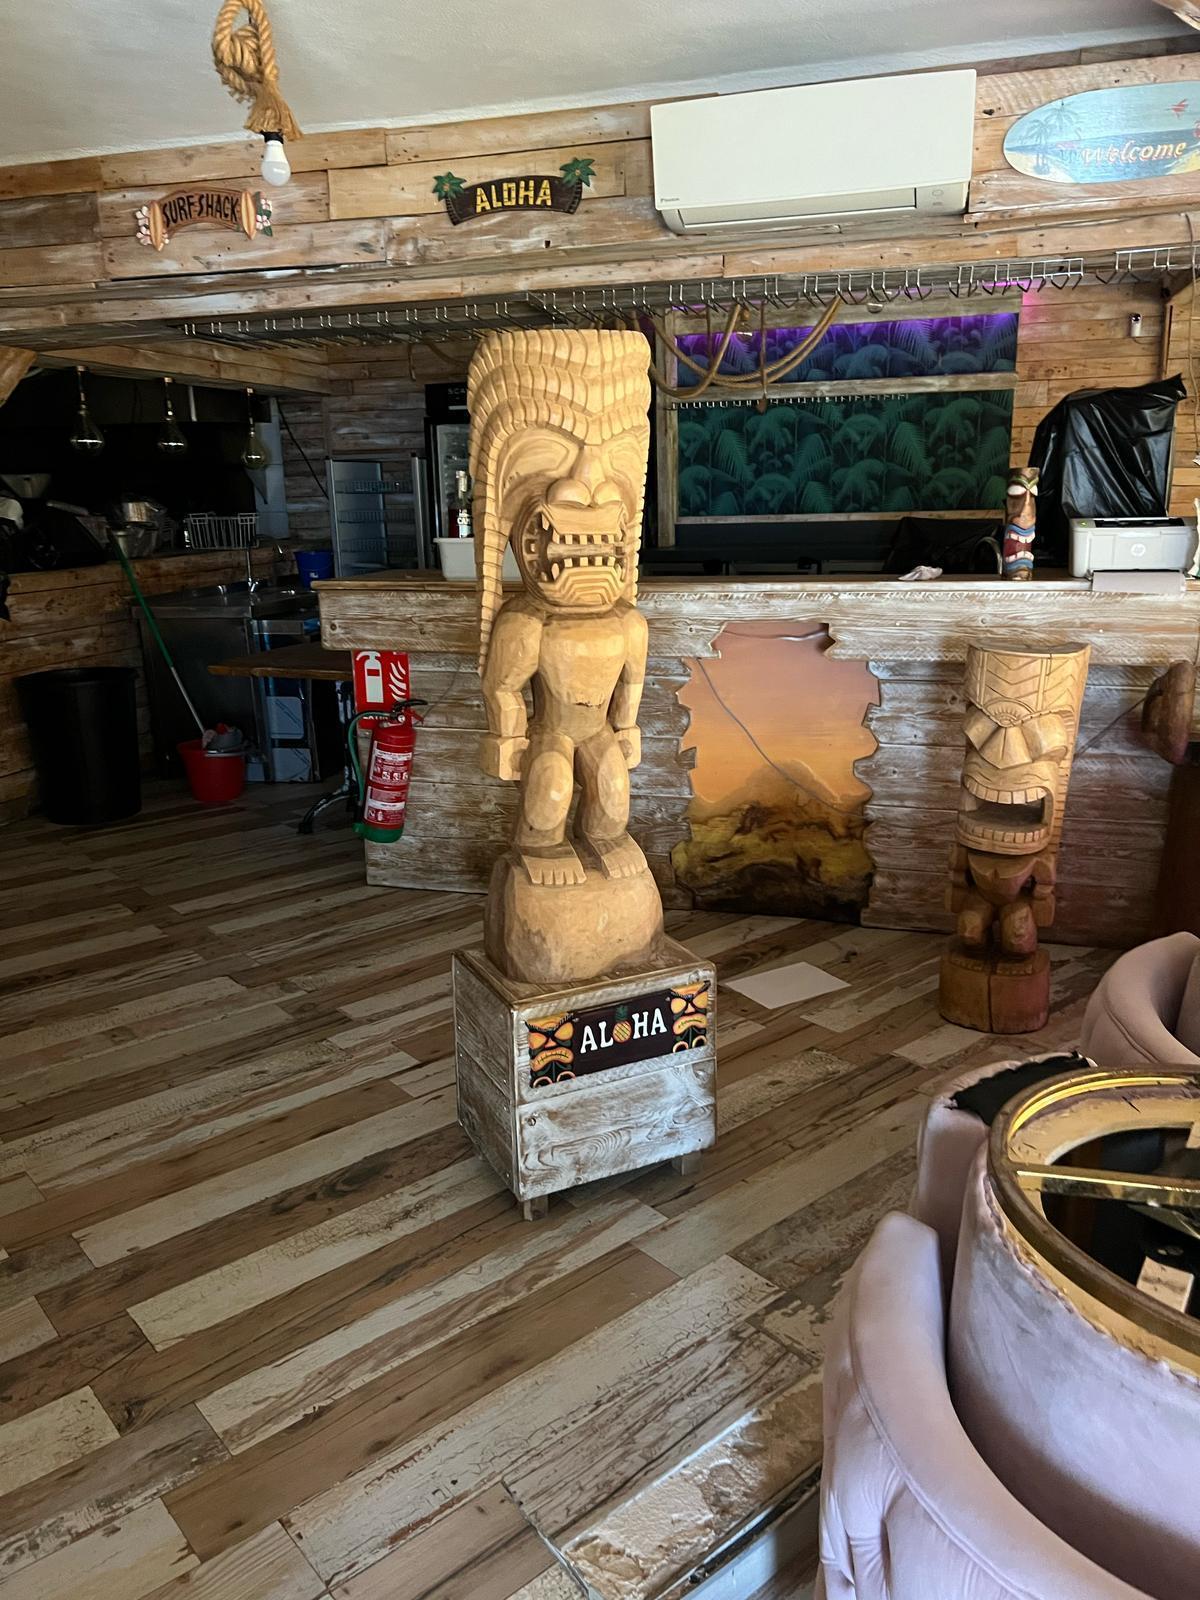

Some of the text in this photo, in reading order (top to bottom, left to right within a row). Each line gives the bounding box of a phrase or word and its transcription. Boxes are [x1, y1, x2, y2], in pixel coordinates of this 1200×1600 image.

[162, 193, 239, 228] SURF SHACK
[475, 179, 552, 213] ALOHA
[580, 1008, 668, 1053] ALOHA
